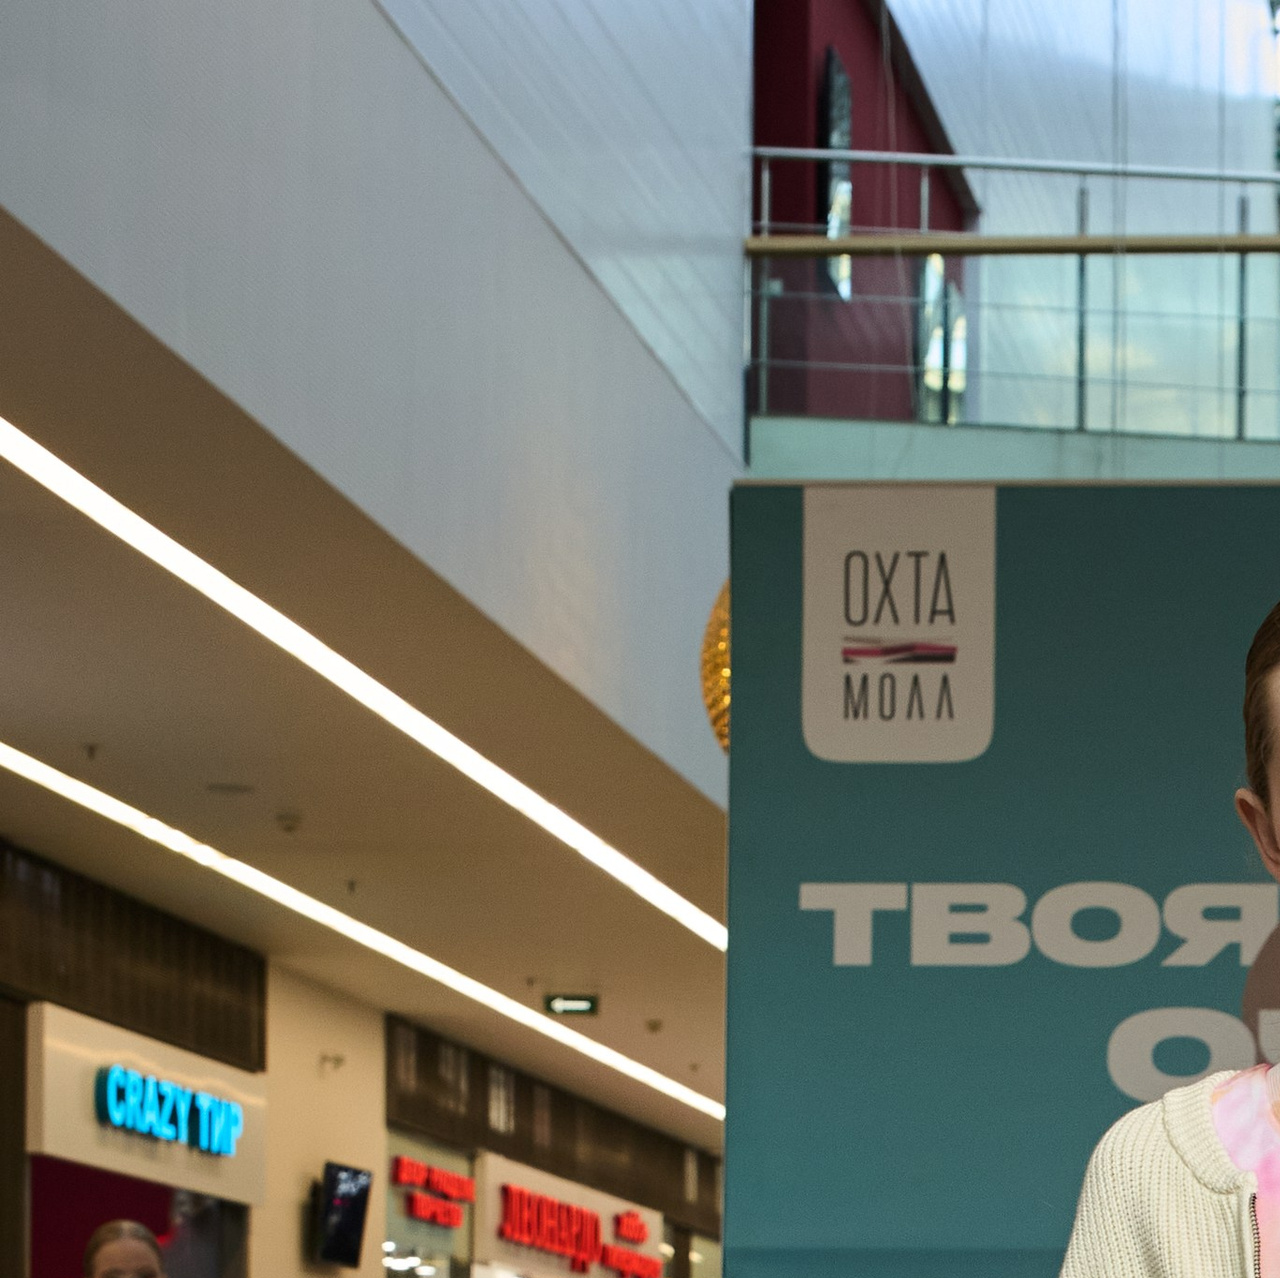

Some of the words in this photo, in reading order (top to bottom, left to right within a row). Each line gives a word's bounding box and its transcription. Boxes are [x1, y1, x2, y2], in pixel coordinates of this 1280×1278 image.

[842, 550, 957, 626] ОХТА
[842, 672, 955, 721] МОЛЛ
[799, 881, 1280, 967] ТВОЯ
[106, 1063, 194, 1145] CRAZY
[195, 1091, 244, 1158] ТИР
